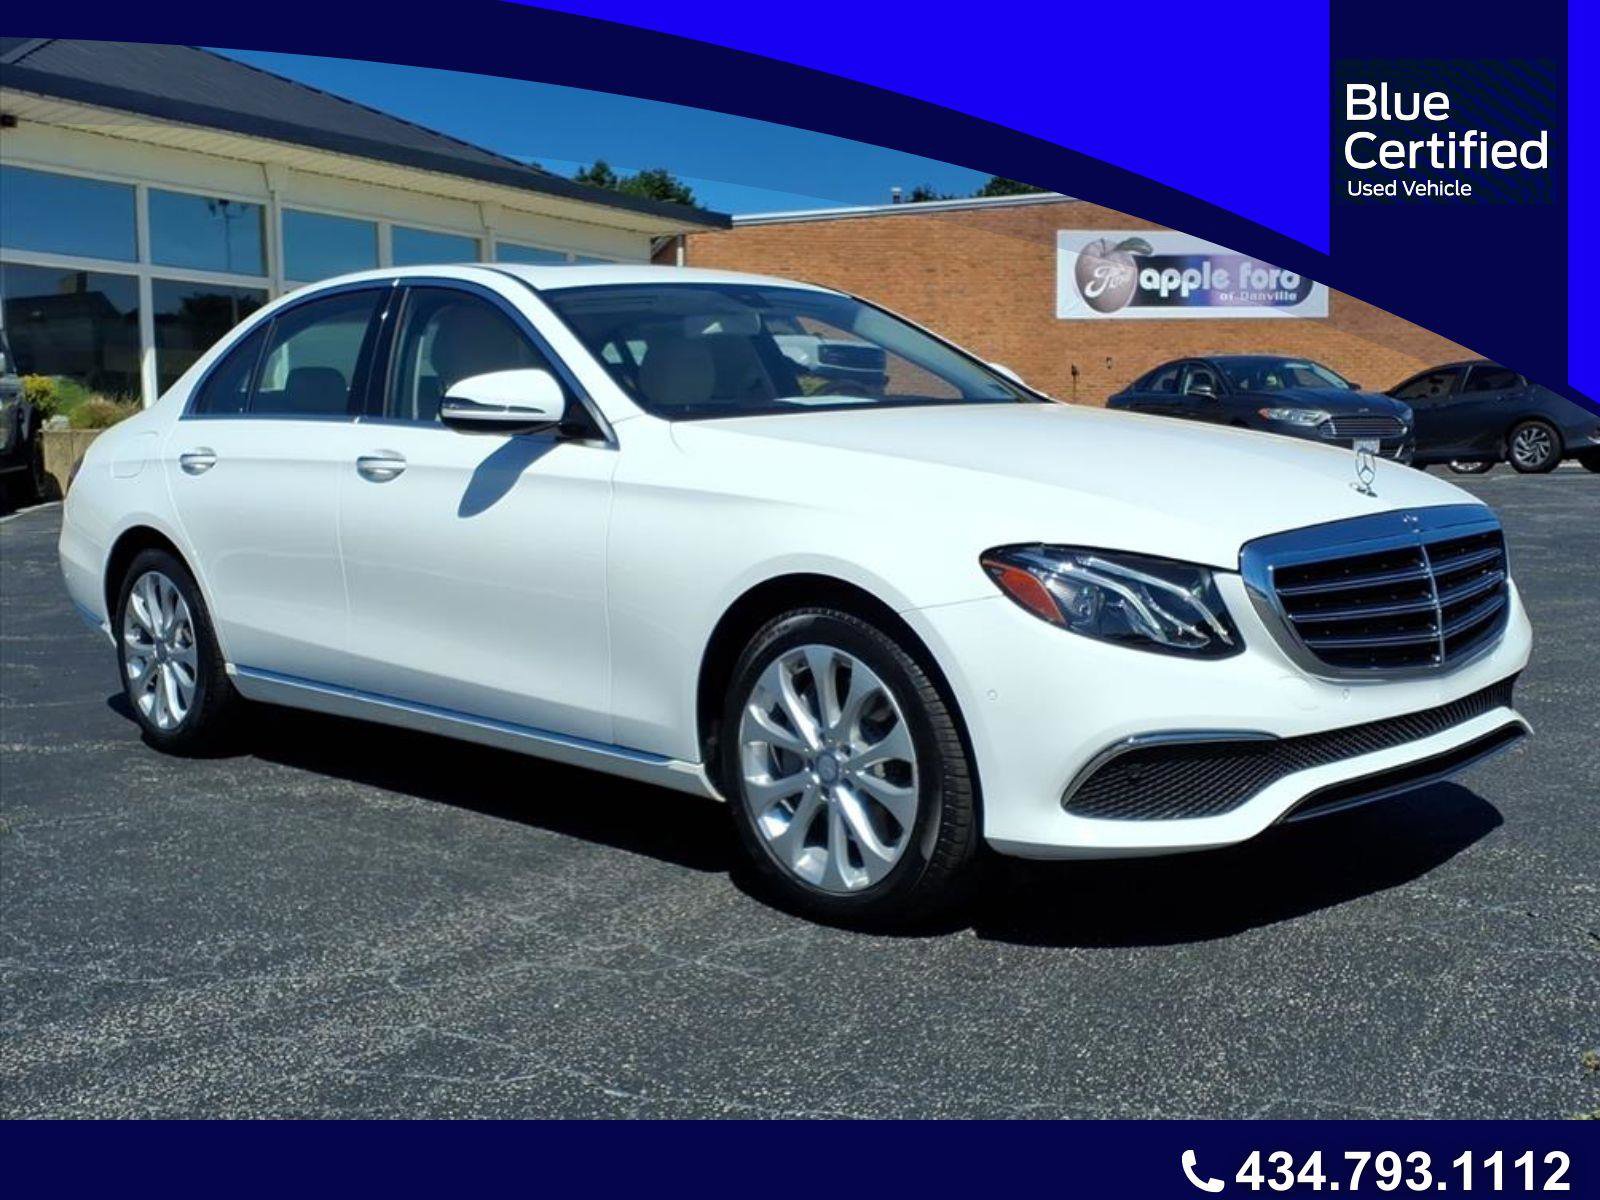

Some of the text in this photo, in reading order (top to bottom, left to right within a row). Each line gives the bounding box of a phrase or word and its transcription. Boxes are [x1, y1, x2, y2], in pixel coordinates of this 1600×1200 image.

[1139, 261, 1231, 298] apple
[1219, 290, 1298, 302] of Danville
